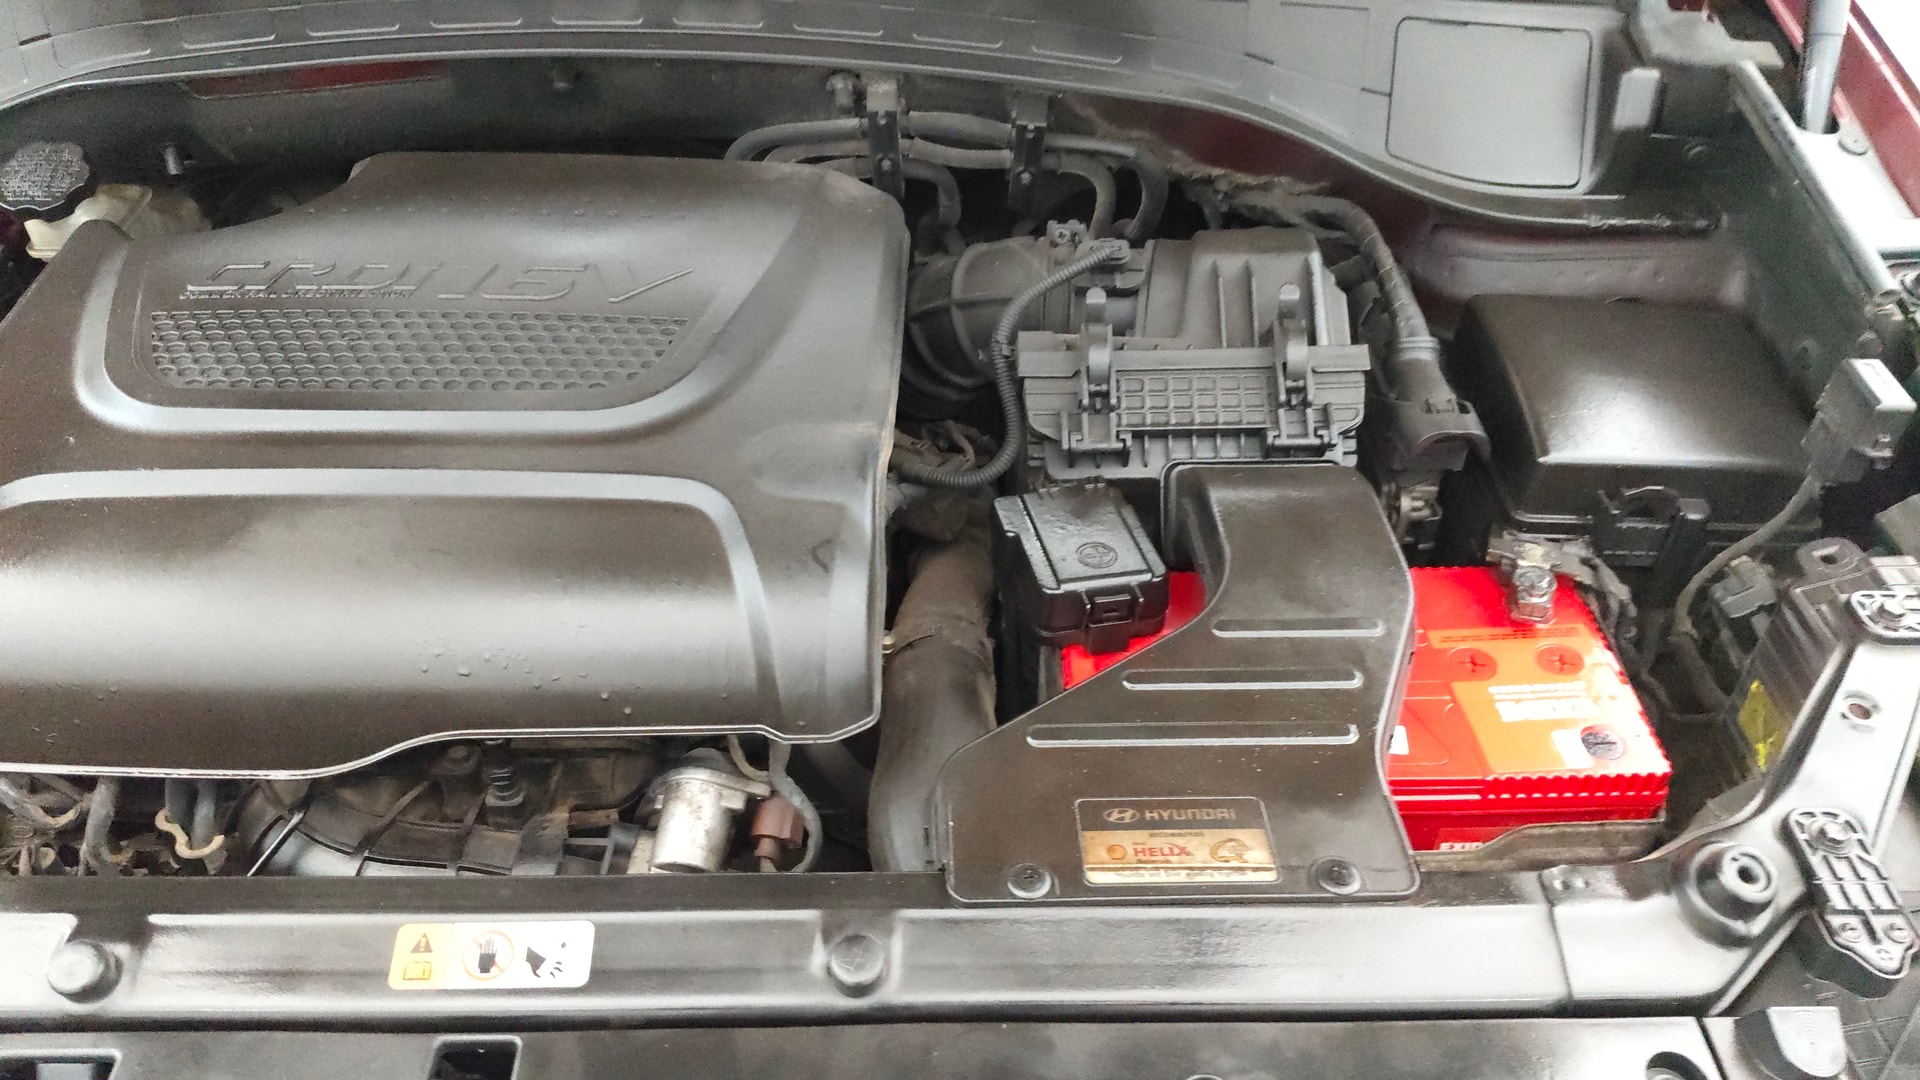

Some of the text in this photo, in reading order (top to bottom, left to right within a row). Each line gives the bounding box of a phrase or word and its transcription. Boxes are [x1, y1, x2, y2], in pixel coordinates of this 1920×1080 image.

[1144, 808, 1237, 821] HYUNDAI
[1132, 846, 1194, 857] HELIX
[1439, 841, 1484, 851] EXID
